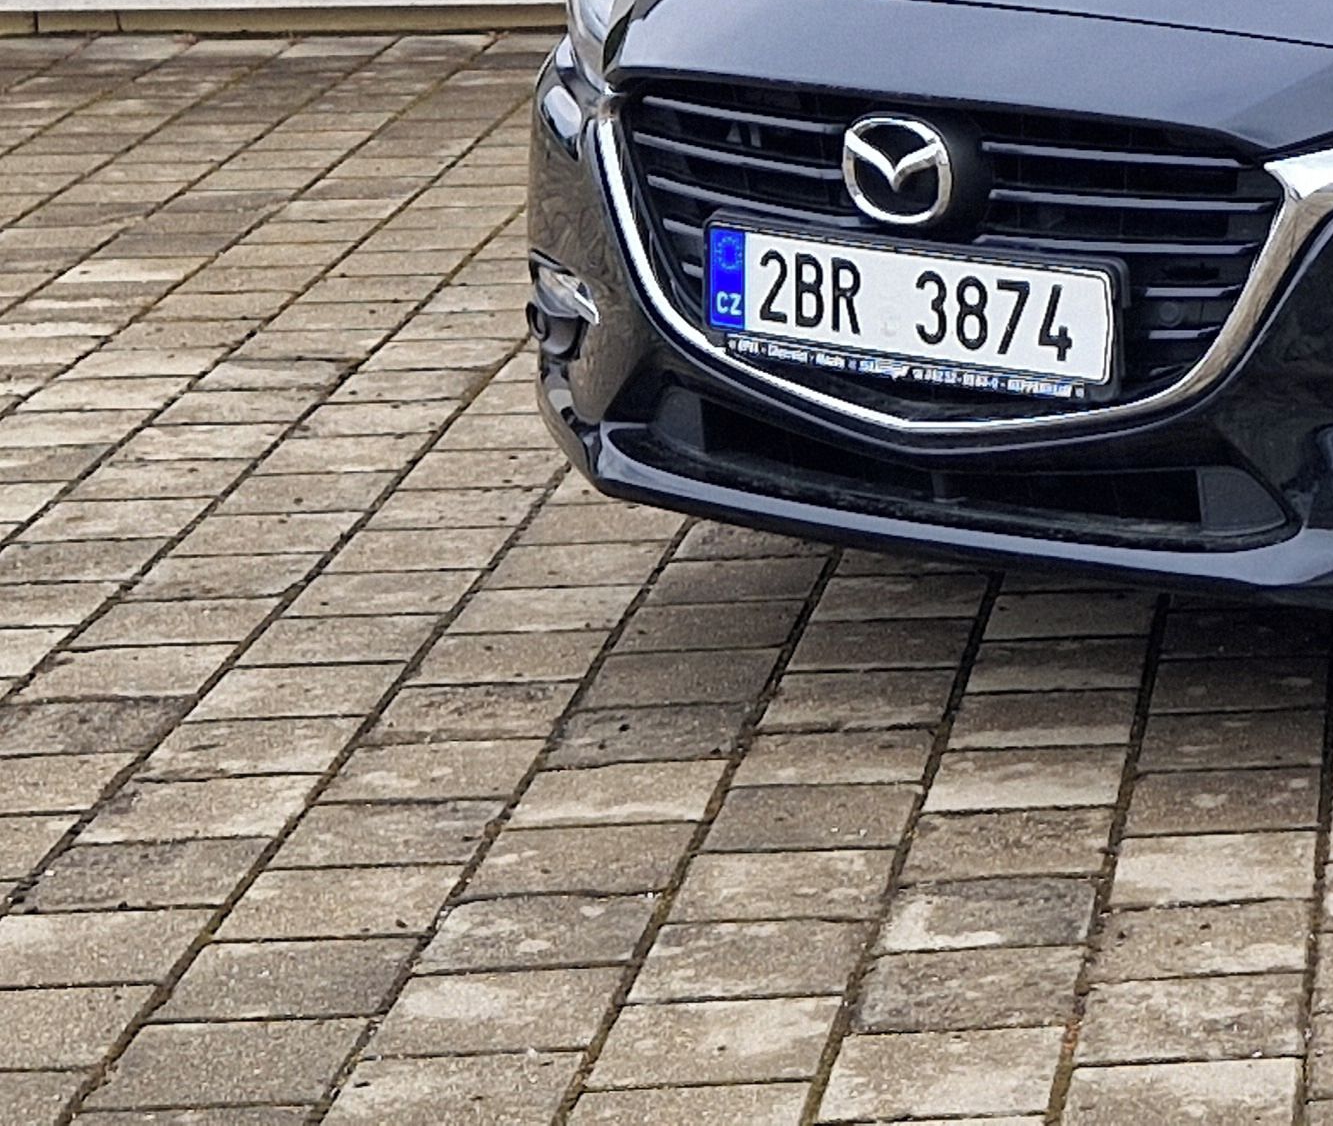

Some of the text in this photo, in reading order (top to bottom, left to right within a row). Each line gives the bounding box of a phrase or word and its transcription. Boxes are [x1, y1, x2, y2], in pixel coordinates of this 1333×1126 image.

[716, 291, 742, 316] CZ
[759, 250, 1073, 362] 2BR 3874
